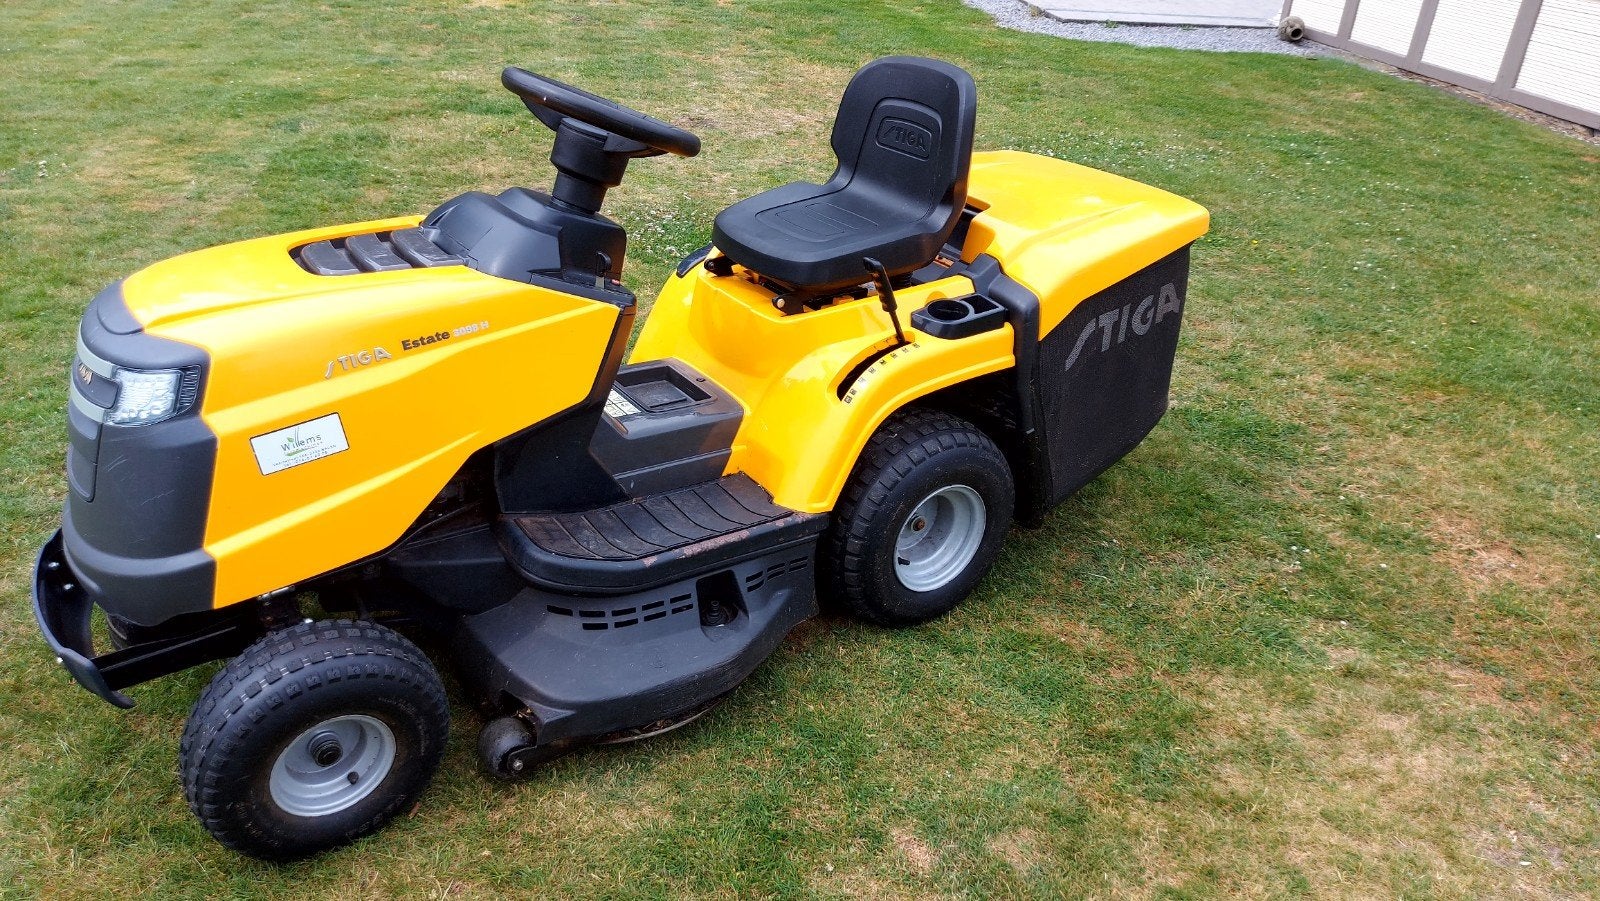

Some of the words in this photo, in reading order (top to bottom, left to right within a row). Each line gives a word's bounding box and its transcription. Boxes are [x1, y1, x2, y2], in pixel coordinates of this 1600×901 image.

[401, 329, 451, 351] Estate
[1064, 282, 1180, 372] STIGA
[324, 346, 392, 379] STIGA
[281, 428, 322, 451] Willems
